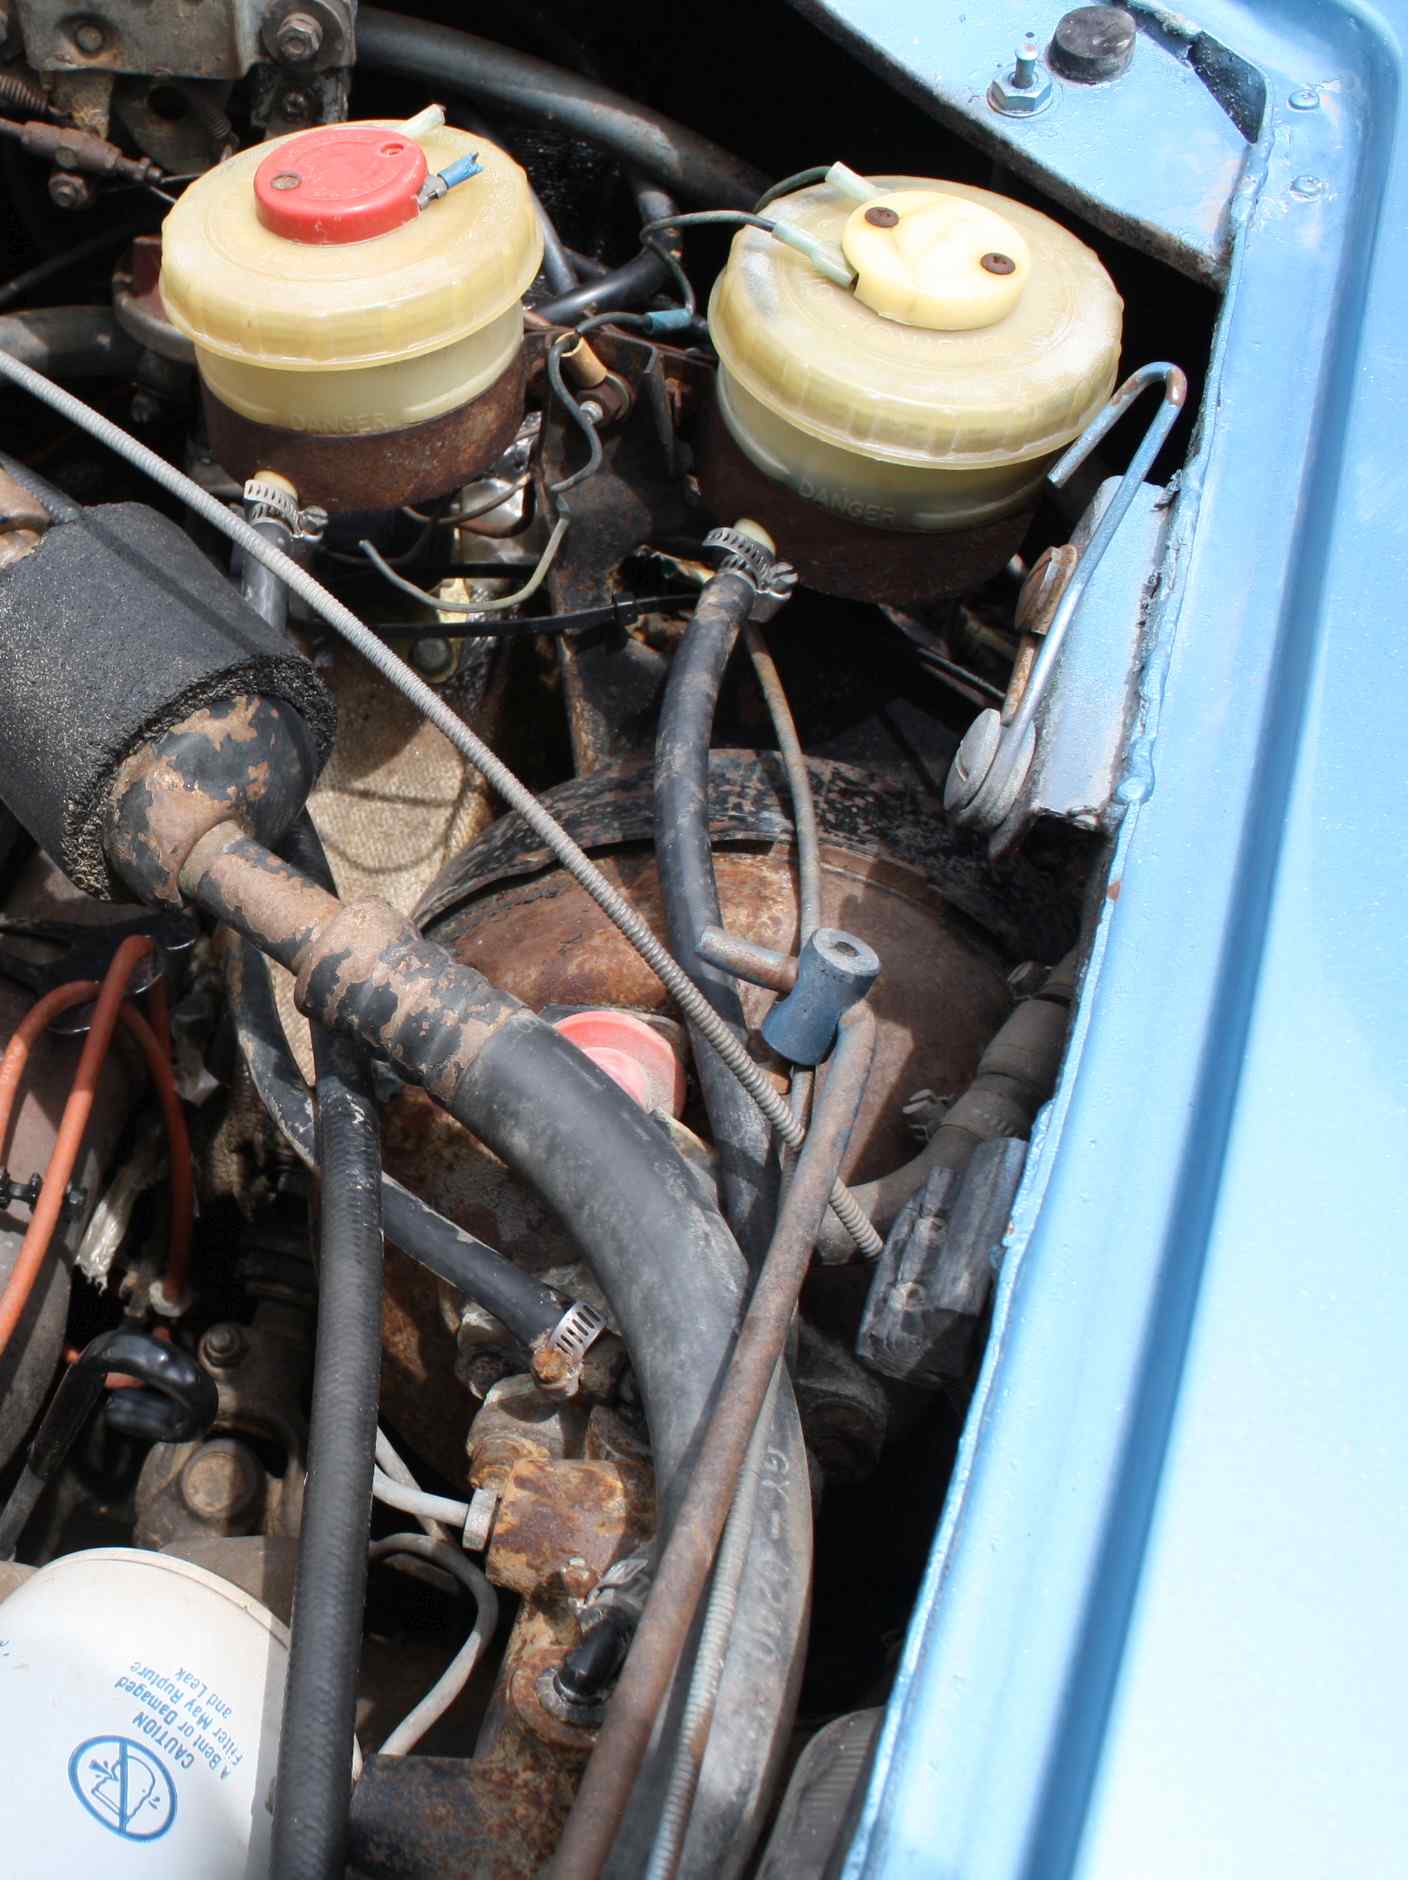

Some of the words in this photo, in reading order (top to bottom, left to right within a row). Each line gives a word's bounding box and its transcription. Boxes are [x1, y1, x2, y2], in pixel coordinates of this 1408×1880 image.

[288, 413, 388, 435] DANGER
[798, 478, 897, 526] DANGER
[130, 1661, 184, 1704] Rupture
[175, 1667, 208, 1698] Leak
[114, 1676, 179, 1725] Damaged
[184, 1699, 213, 1730] May
[206, 1693, 232, 1719] and
[132, 1711, 195, 1769] CAUTION
[177, 1721, 194, 1738] or
[193, 1735, 222, 1770] Bent
[212, 1728, 243, 1766] Filter
[219, 1765, 231, 1781] A
